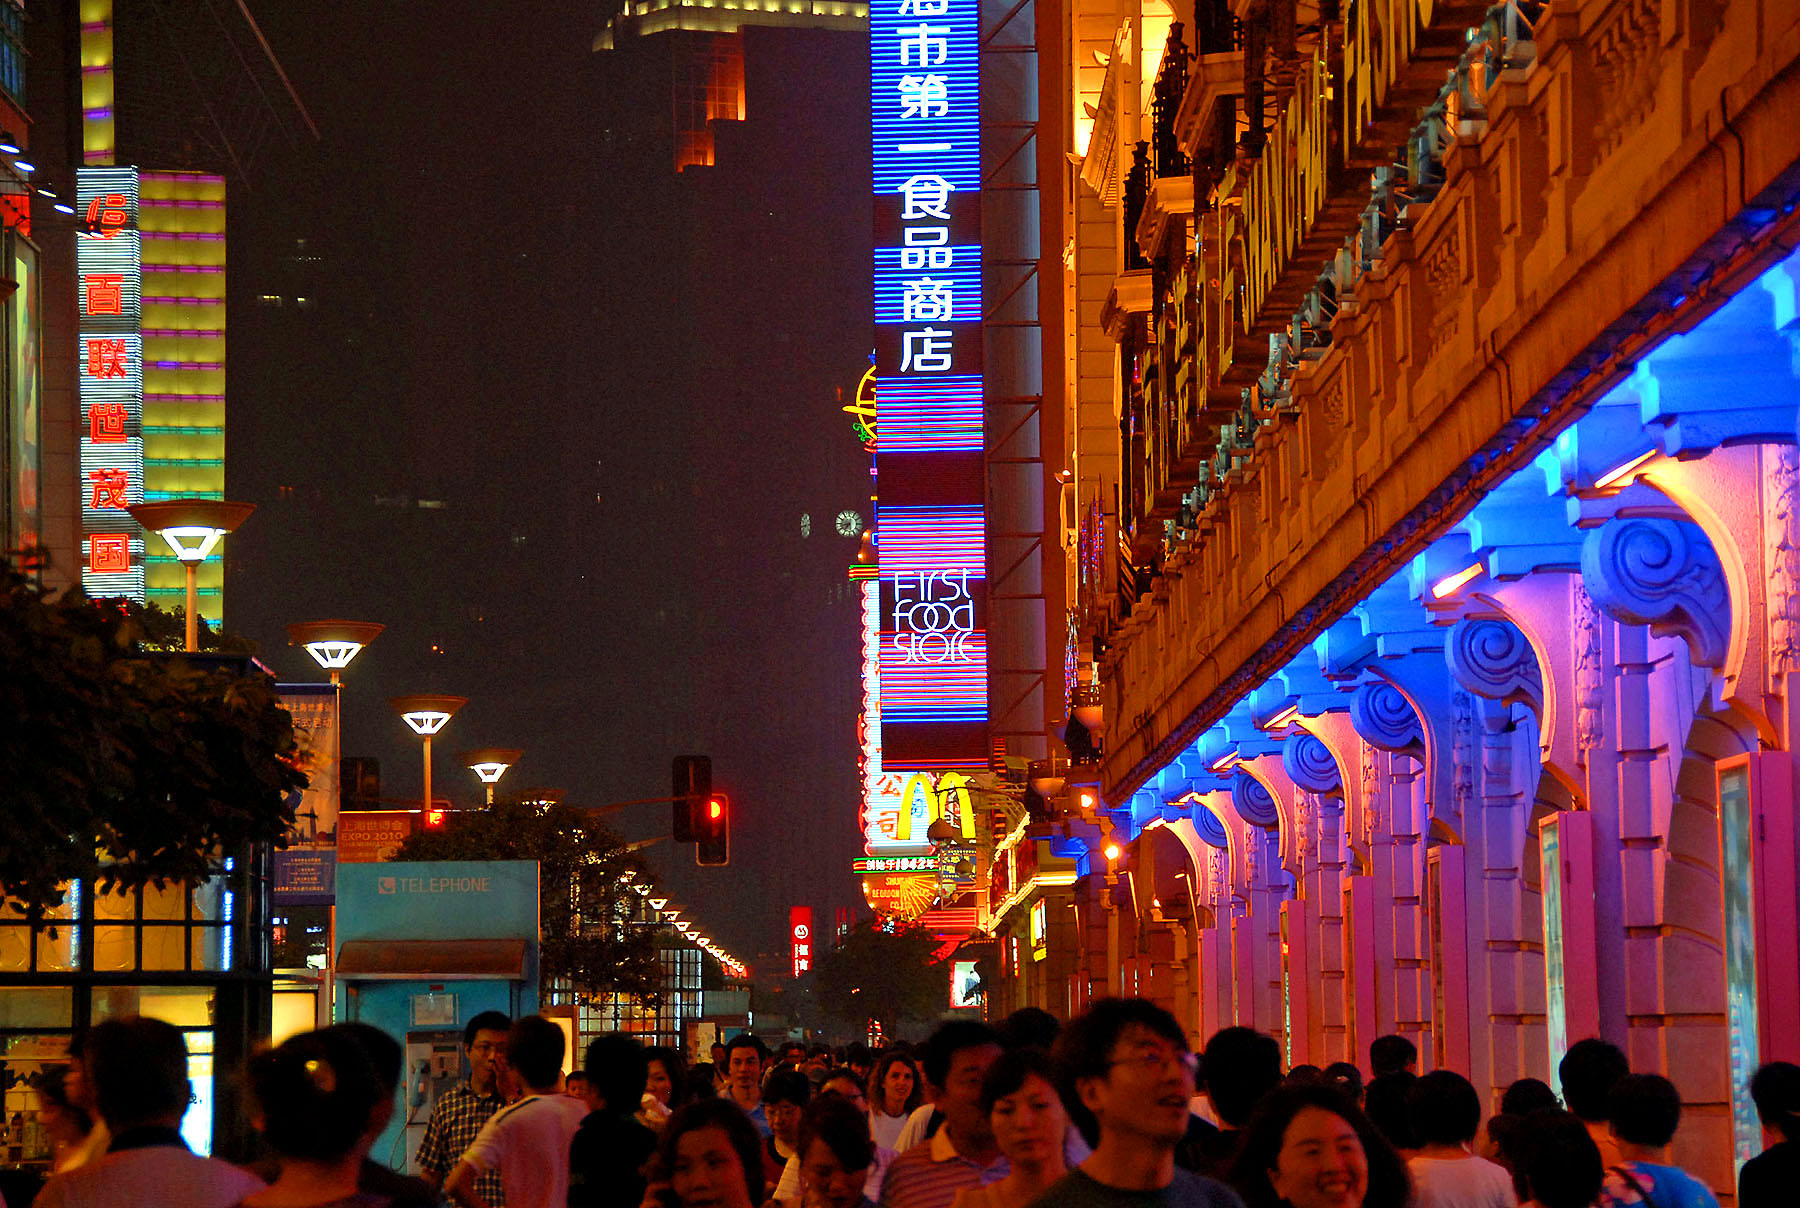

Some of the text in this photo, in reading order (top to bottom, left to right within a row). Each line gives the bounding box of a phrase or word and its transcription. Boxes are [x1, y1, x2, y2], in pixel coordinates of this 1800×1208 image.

[341, 831, 404, 841] EXPO 2010
[399, 877, 490, 893] TELEPHONE
